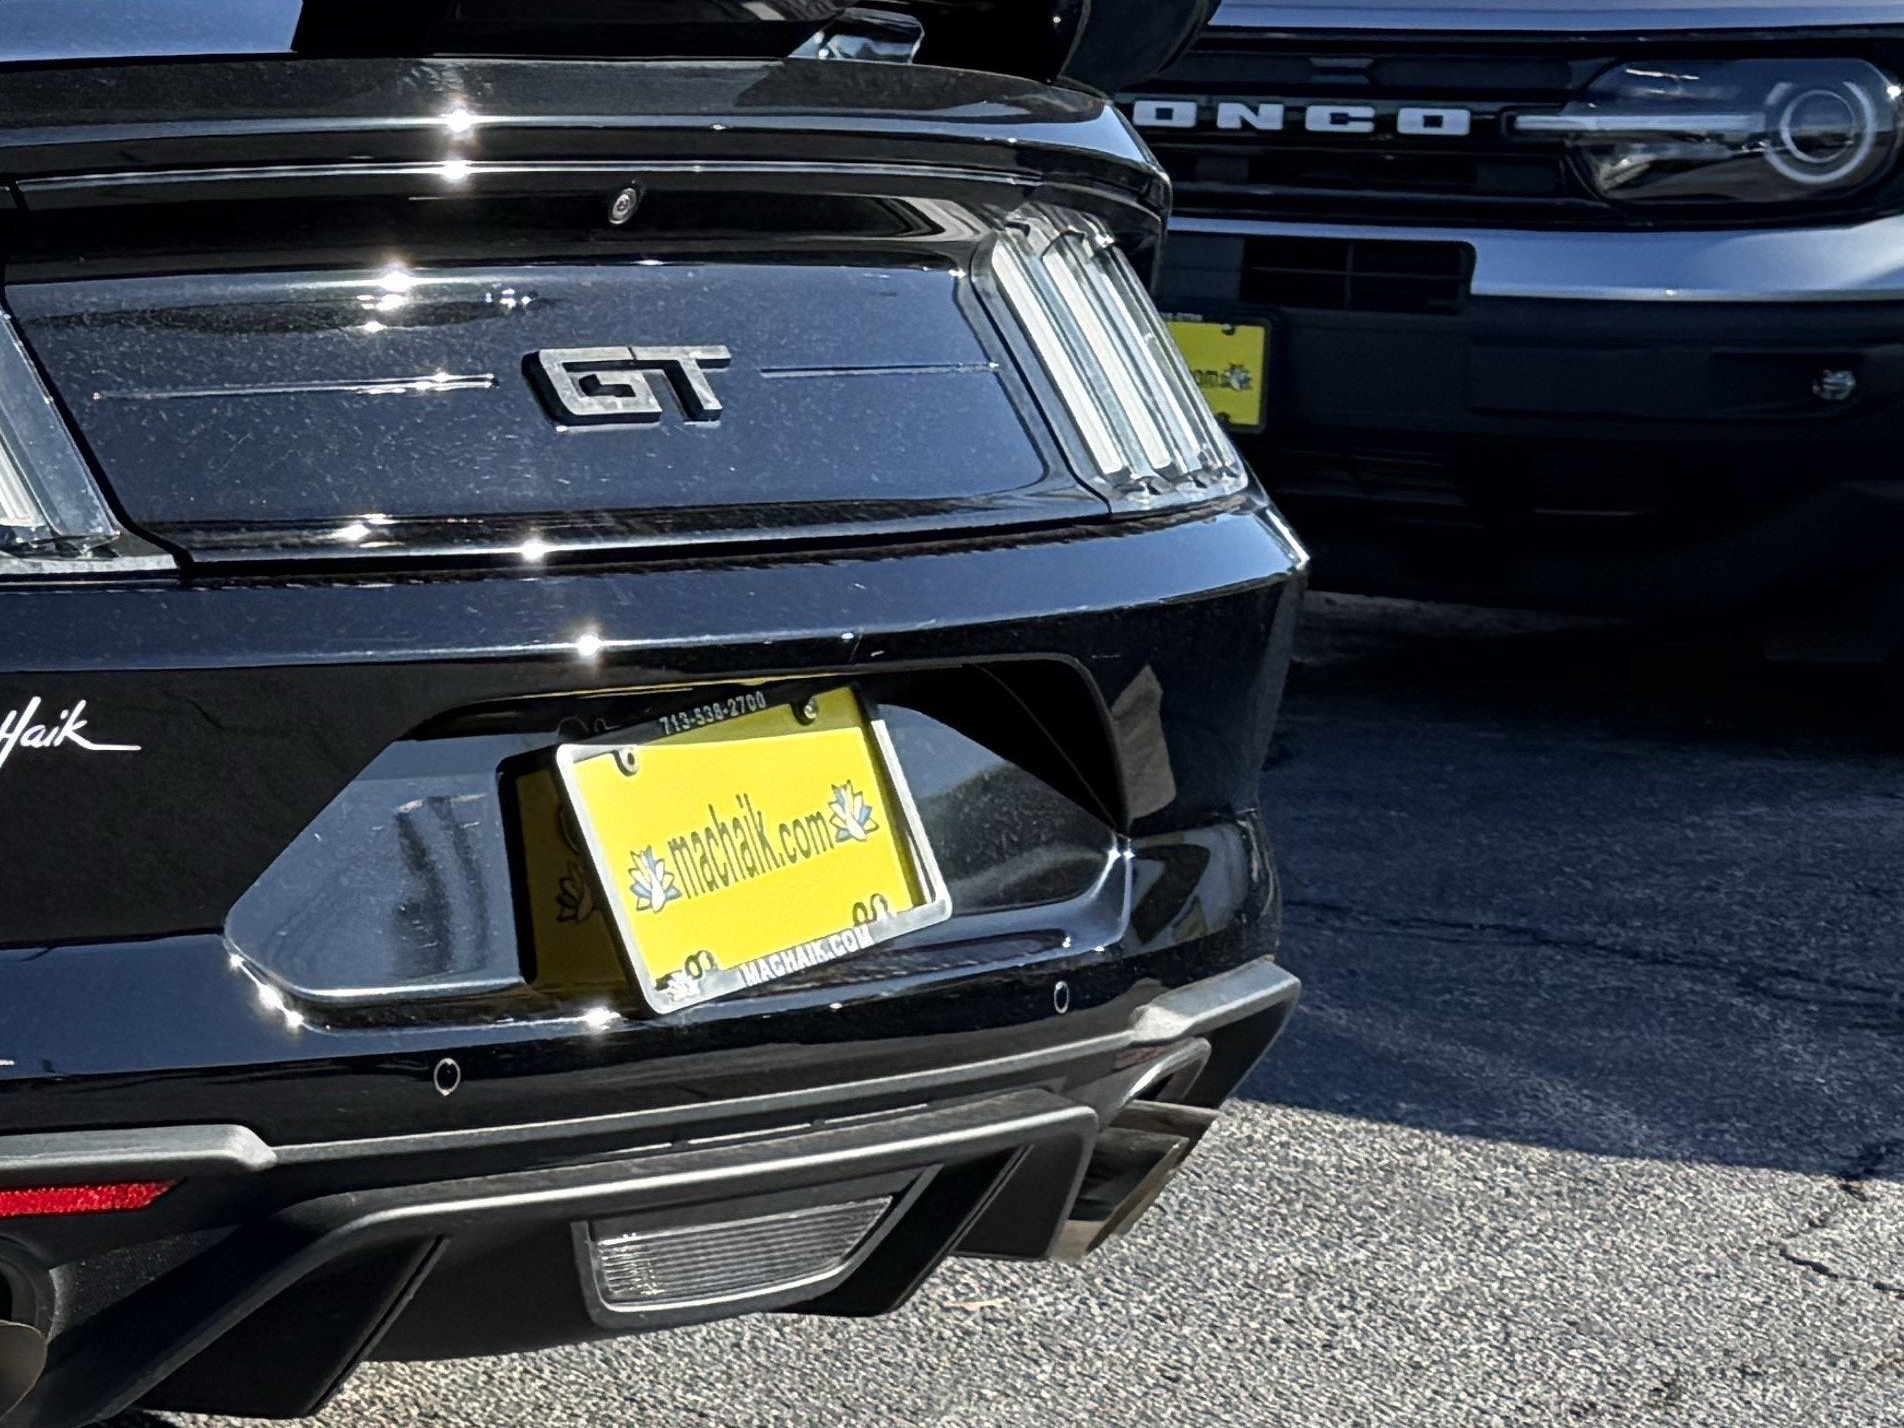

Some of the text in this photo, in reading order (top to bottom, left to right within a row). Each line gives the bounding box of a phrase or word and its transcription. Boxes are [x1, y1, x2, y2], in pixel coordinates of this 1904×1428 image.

[1133, 100, 1472, 136] ONCO
[525, 344, 733, 423] GT
[658, 690, 768, 736] 713-538-2700
[667, 792, 835, 900] machaik.com
[739, 924, 874, 988] MACHAIK.COM
